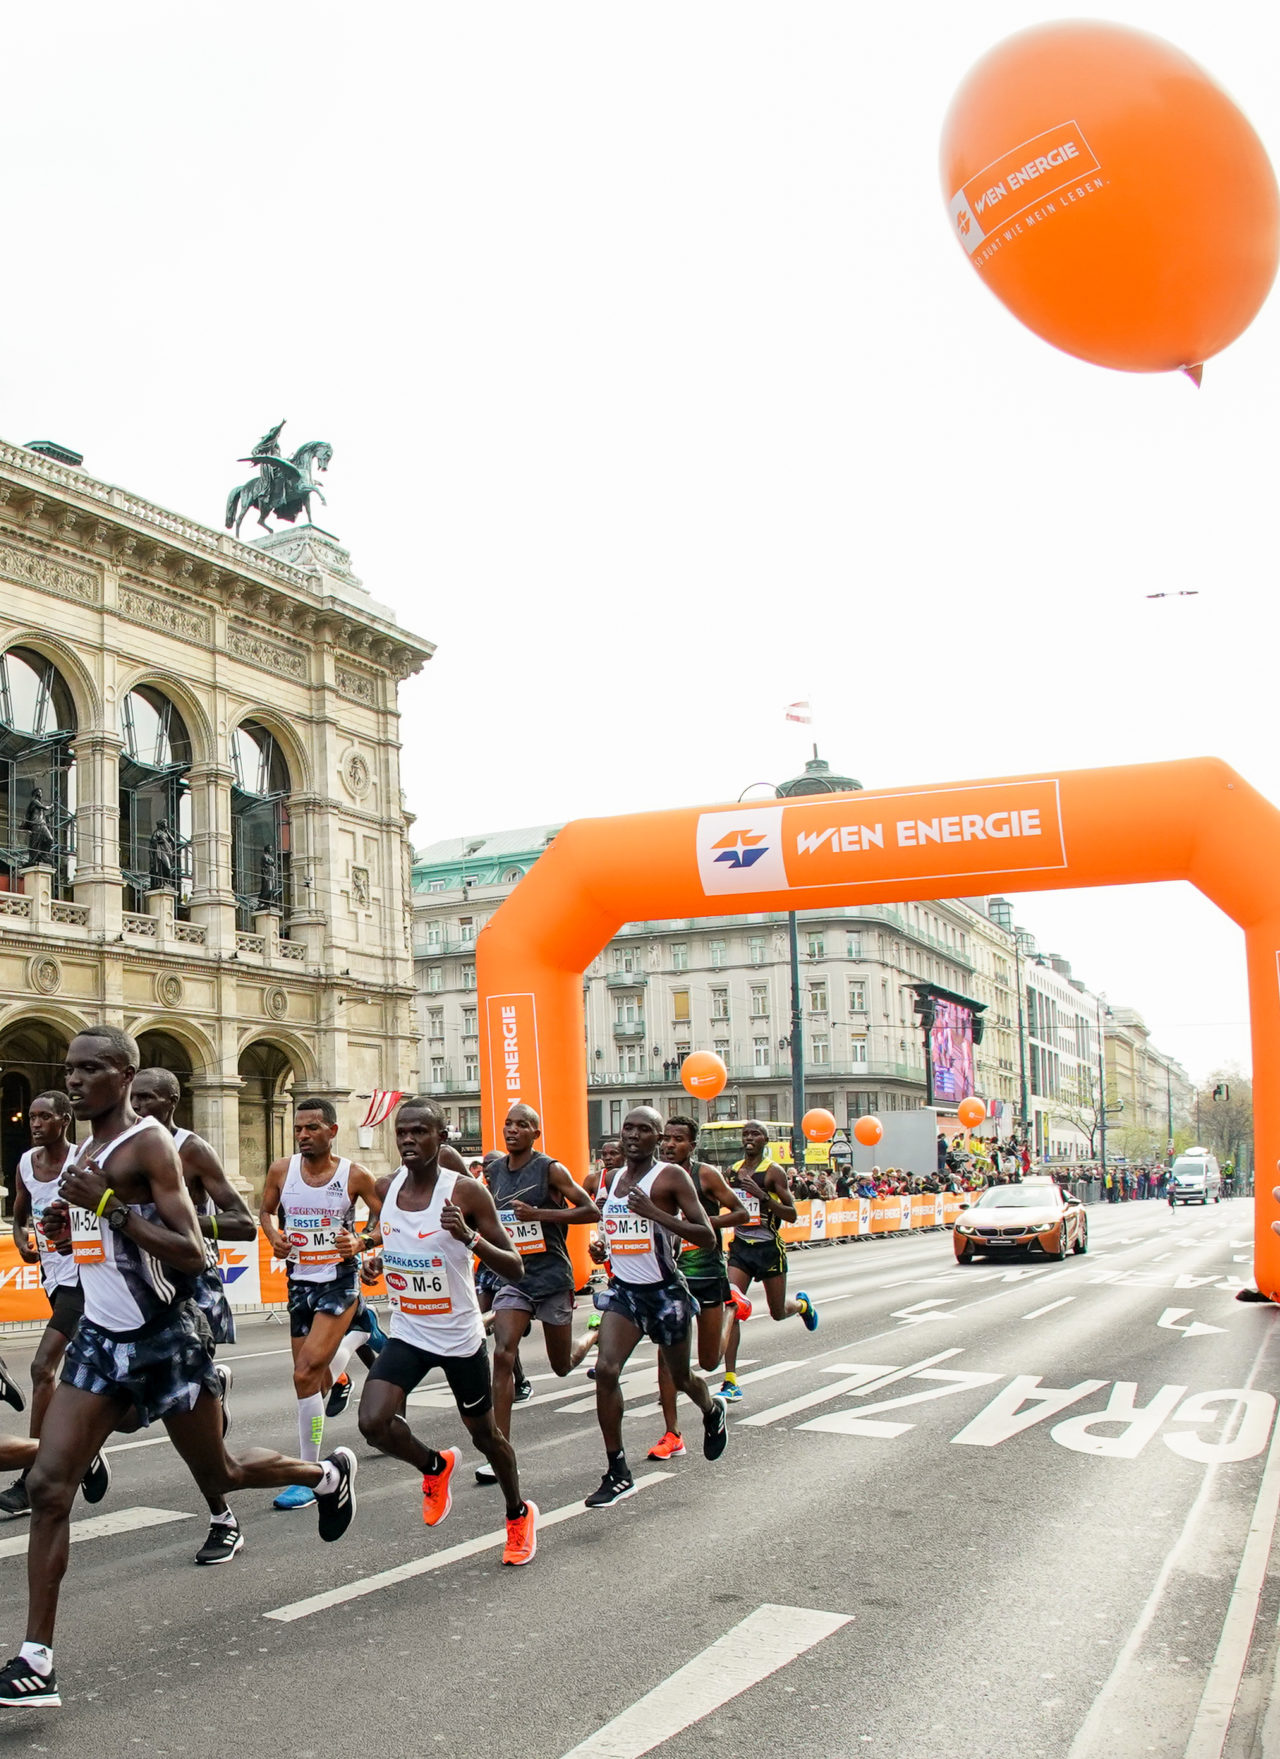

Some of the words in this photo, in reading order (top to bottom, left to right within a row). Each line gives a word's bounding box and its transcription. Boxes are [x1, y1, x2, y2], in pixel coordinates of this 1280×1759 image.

[974, 181, 1008, 215] WIEN
[1006, 141, 1080, 191] ENERGIE
[982, 238, 1003, 260] BUNT
[1003, 223, 1024, 241] WIE
[1025, 202, 1057, 227] MEIN
[797, 823, 885, 855] WIEN
[897, 808, 1042, 848] ENERGIE
[501, 1005, 521, 1090] ENERGIE
[72, 1210, 98, 1231] M-52
[294, 1218, 320, 1228] ERSTE
[618, 1219, 648, 1233] M-15
[313, 1231, 337, 1246] M-3
[516, 1224, 538, 1238] M-5
[383, 1254, 431, 1268] SPARKASSE
[412, 1276, 442, 1292] M-6
[794, 1368, 1277, 1465] GRAZ
